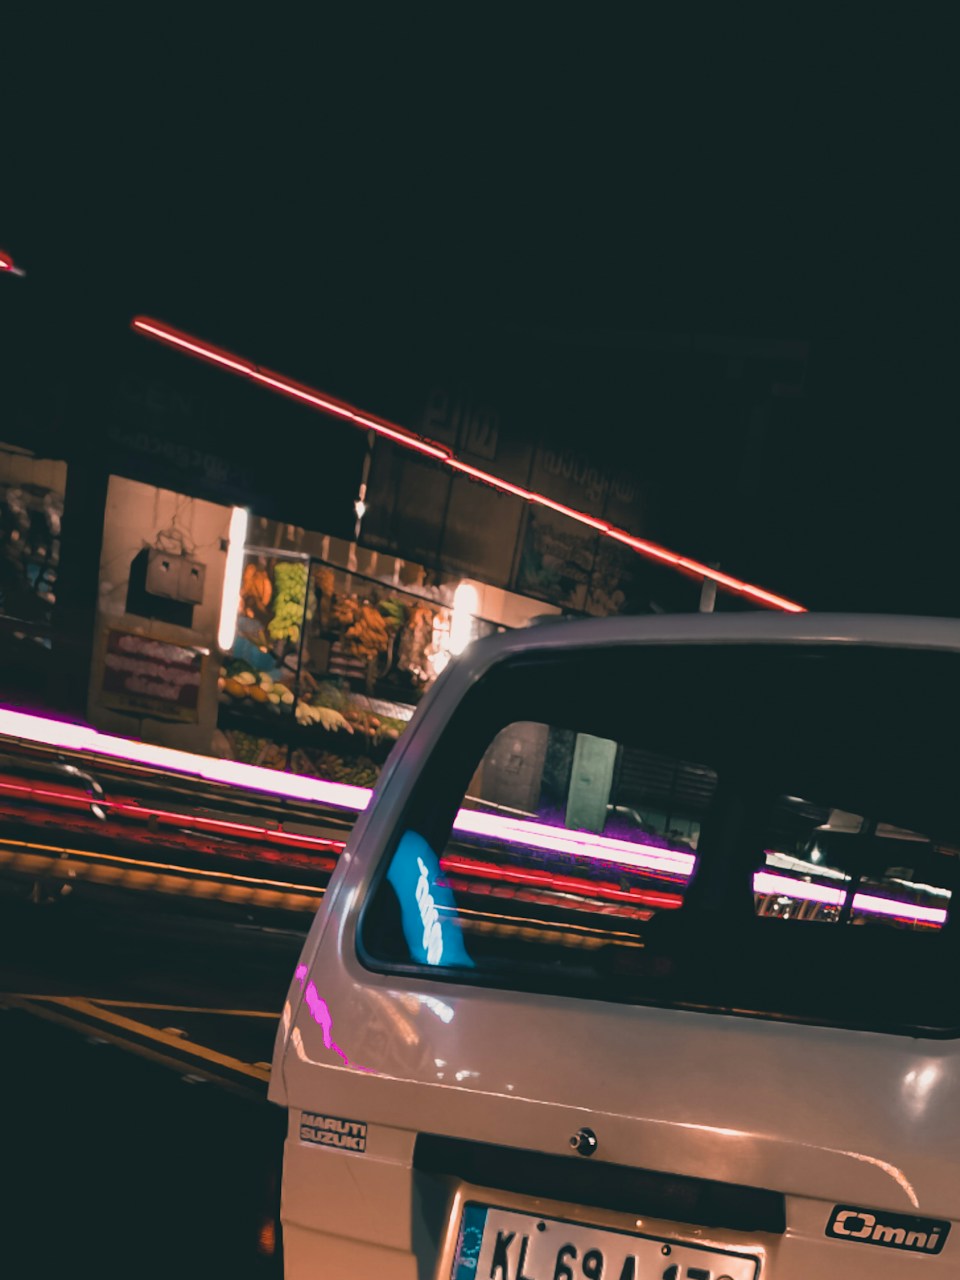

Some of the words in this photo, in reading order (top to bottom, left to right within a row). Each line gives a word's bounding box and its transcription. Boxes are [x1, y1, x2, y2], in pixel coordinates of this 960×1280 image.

[301, 1113, 366, 1137] MARUTI
[300, 1127, 365, 1151] SUZUKI
[832, 1210, 941, 1249] Omni
